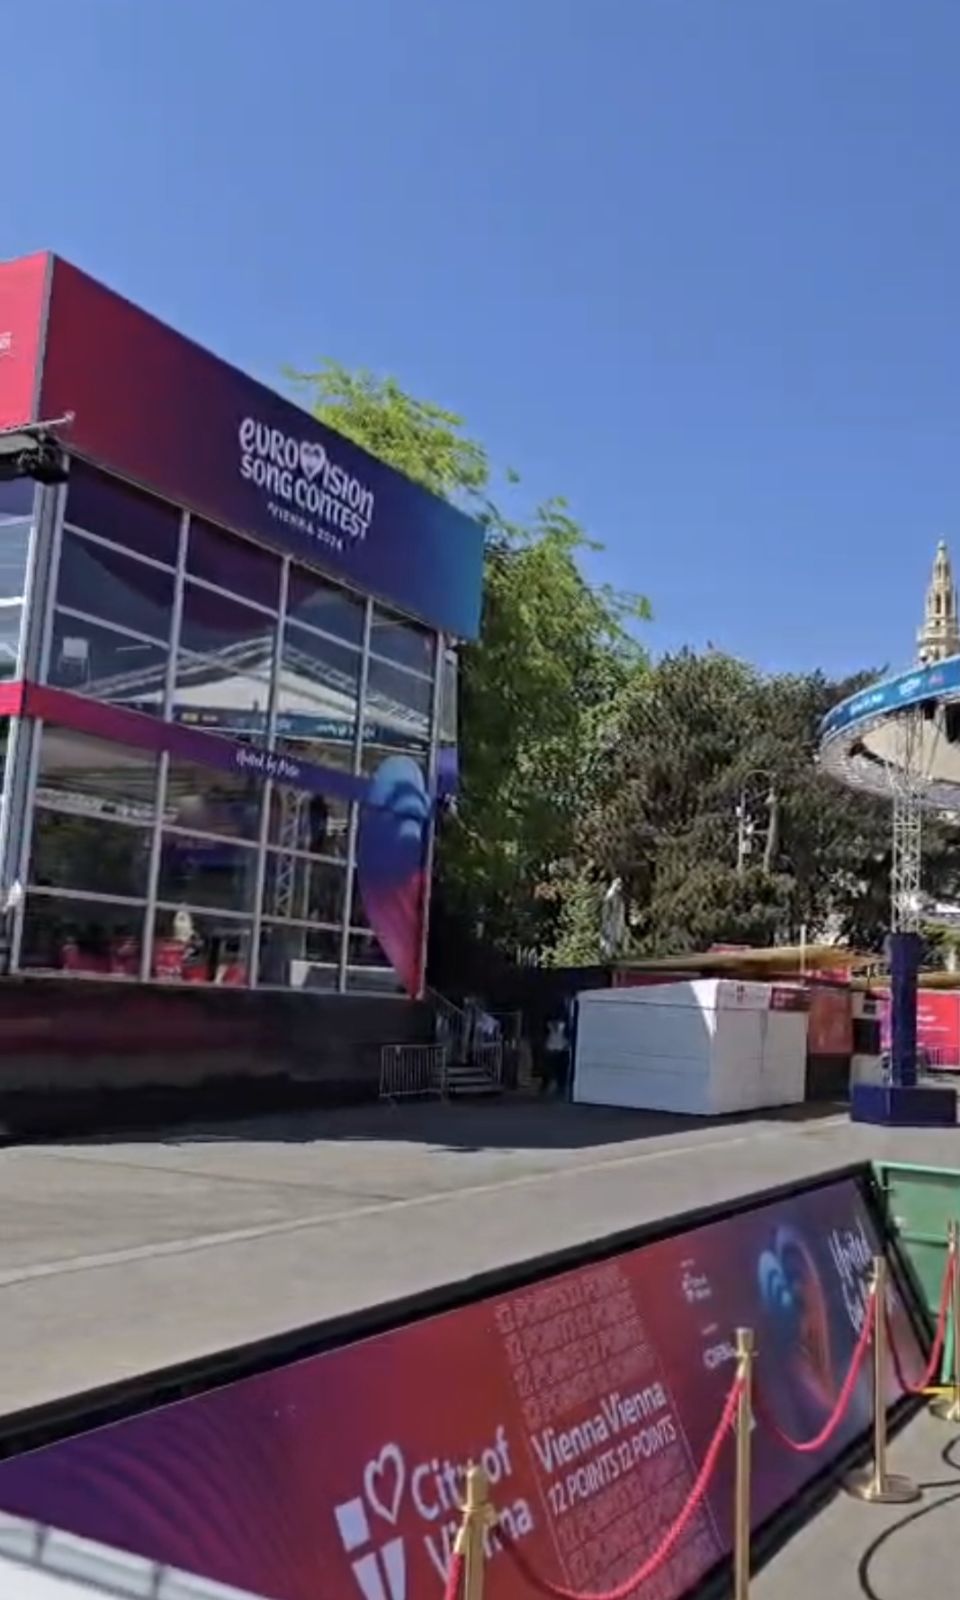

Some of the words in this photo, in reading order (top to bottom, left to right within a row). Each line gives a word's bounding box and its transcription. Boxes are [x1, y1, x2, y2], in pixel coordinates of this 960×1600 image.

[481, 1424, 512, 1485] of
[548, 1481, 568, 1516] 12
[617, 1440, 634, 1472] 12
